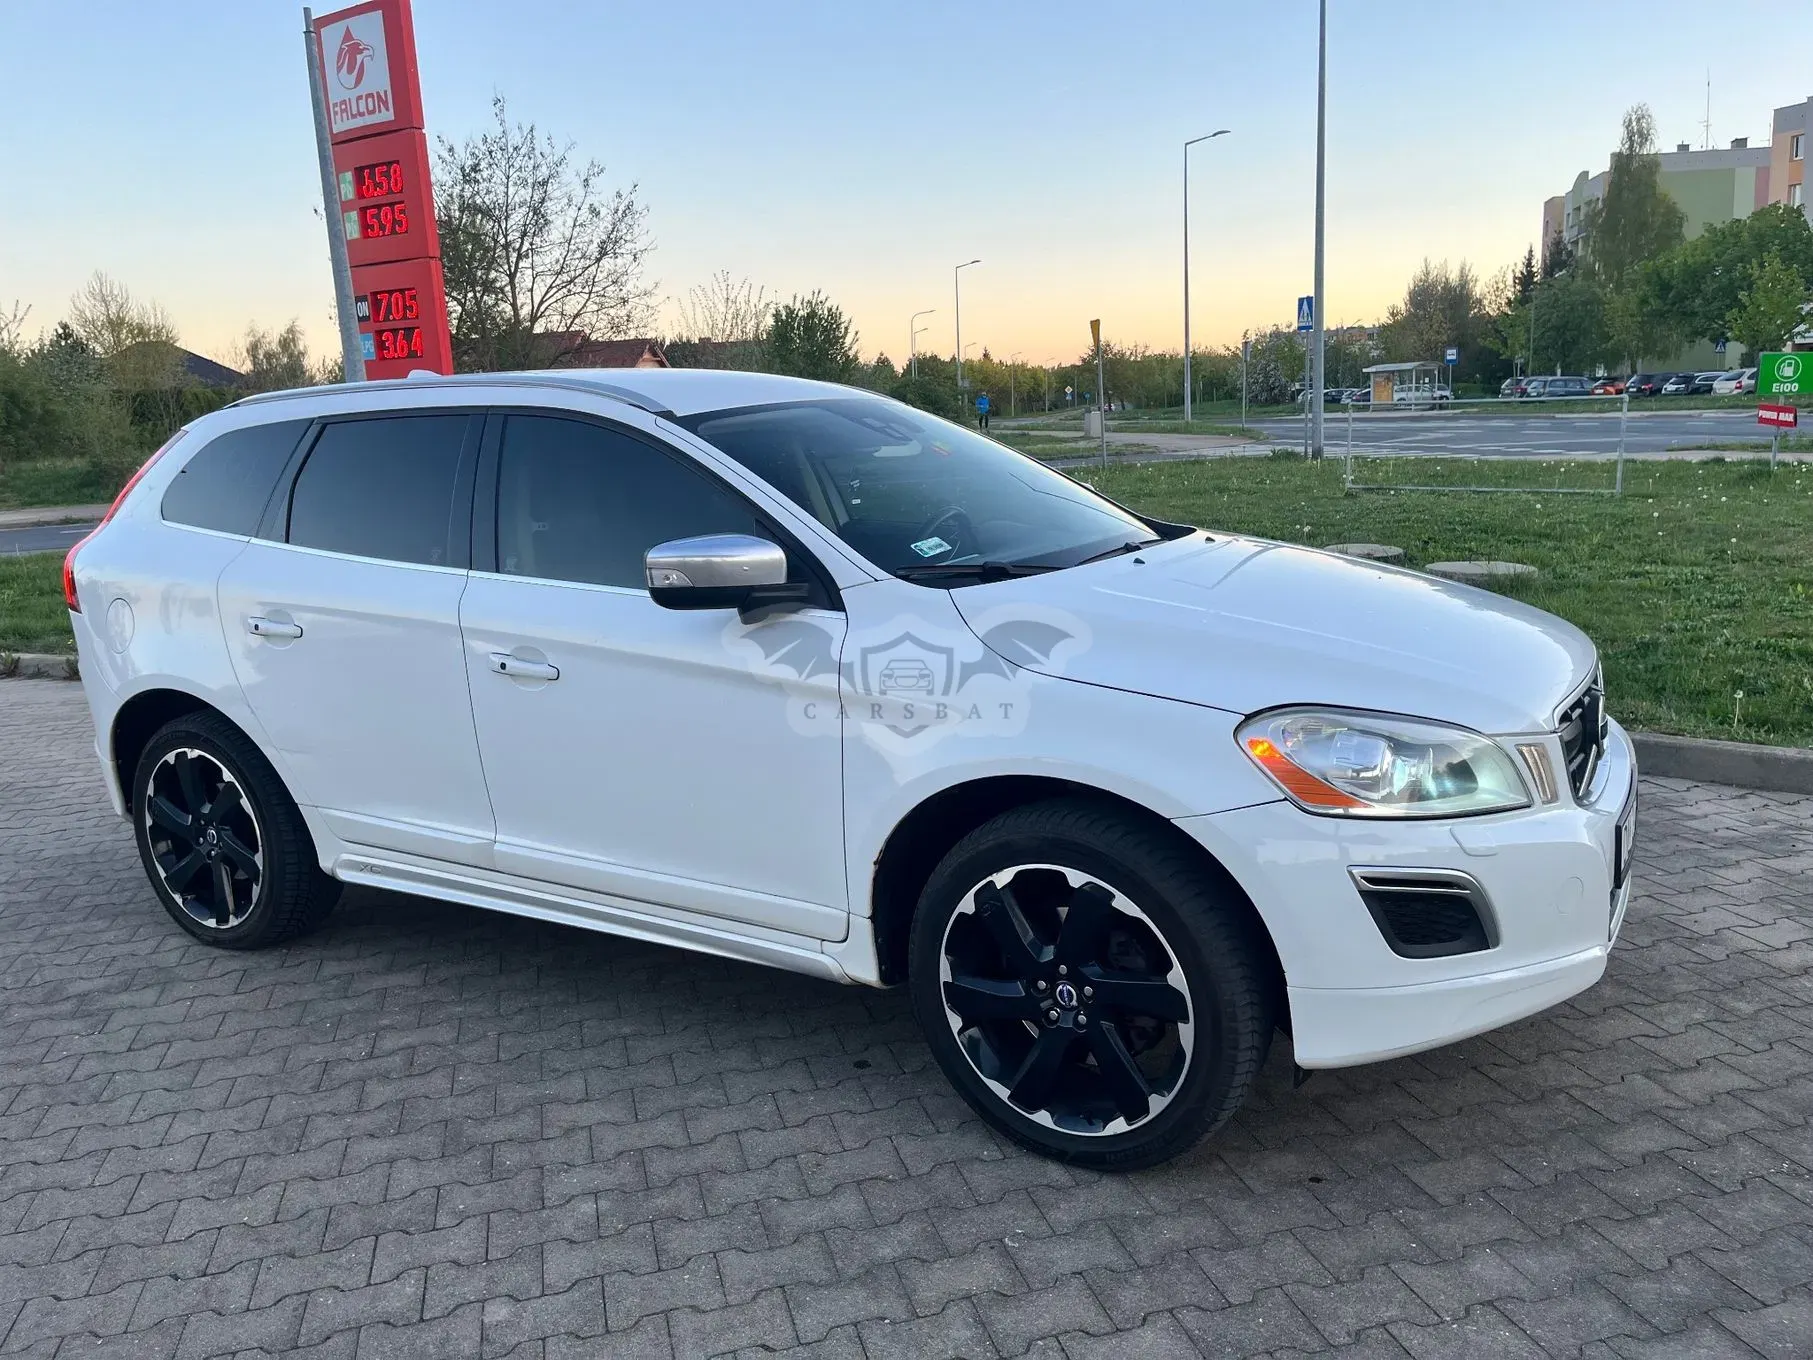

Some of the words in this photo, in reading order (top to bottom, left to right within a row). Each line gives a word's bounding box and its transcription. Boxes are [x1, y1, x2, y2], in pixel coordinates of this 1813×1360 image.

[332, 90, 390, 125] FALCON
[367, 203, 409, 238] 5.95
[357, 301, 370, 318] ON
[377, 290, 418, 322] 7.05
[382, 328, 424, 359] 3.64
[1772, 382, 1799, 393] E100
